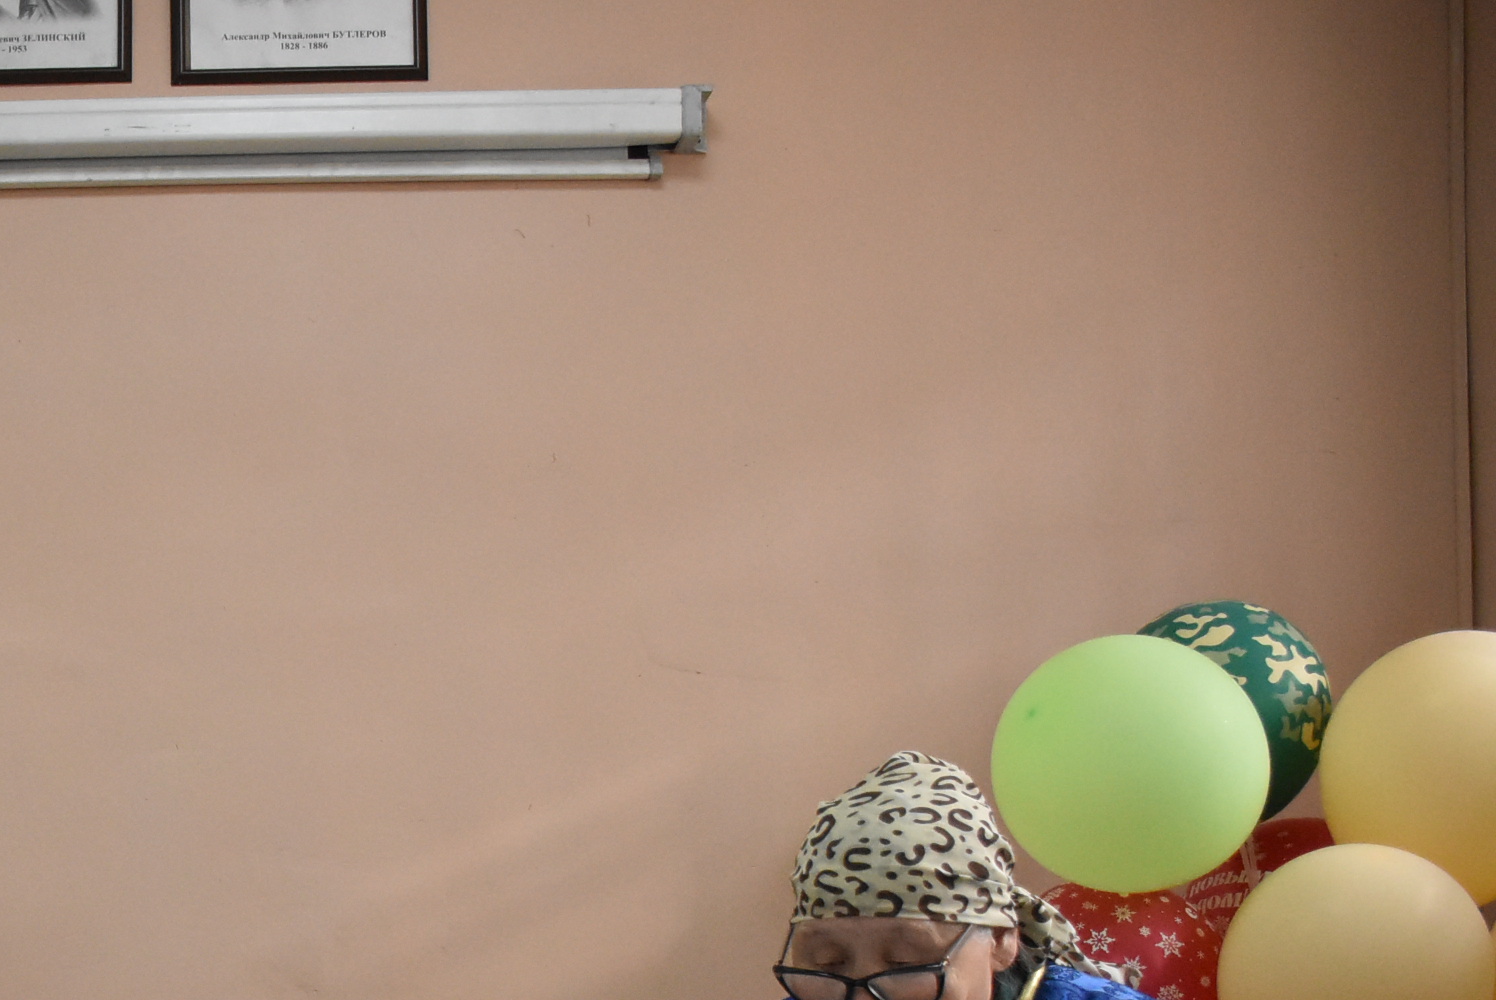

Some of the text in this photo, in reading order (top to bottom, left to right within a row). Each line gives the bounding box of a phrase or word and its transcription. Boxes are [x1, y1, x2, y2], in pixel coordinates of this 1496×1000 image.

[22, 31, 86, 42] ЗЕЛИНСКИЙ
[221, 30, 387, 42] Александр Михайлович БУТЛЕРОВ
[8, 44, 28, 53] 1953
[280, 42, 300, 50] 1828
[308, 41, 328, 50] 1886
